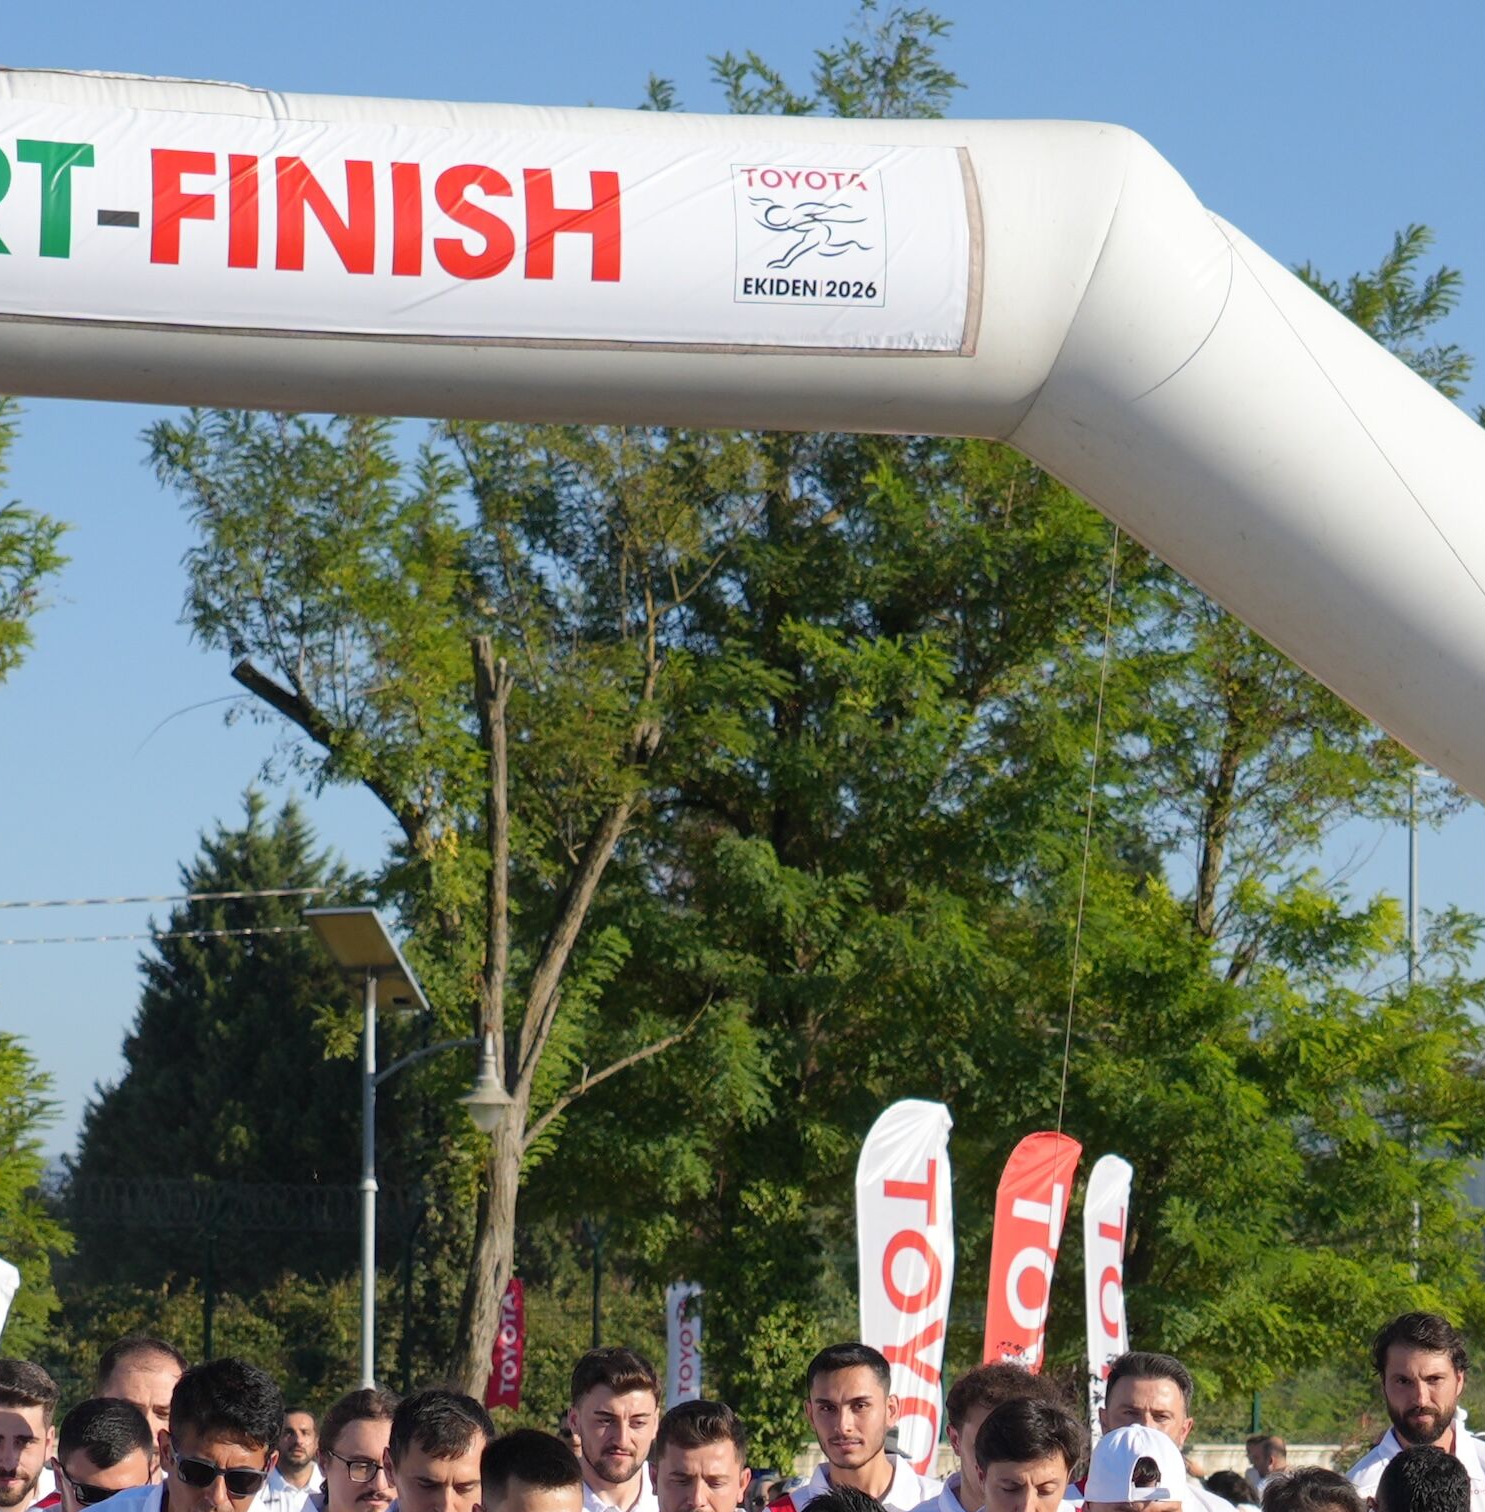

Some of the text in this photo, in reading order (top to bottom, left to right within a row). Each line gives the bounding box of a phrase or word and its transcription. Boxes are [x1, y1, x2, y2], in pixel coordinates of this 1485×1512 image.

[740, 167, 868, 192] TOYOTA
[742, 278, 878, 300] EKIDEN 2026
[498, 1292, 518, 1396] TOYOTA
